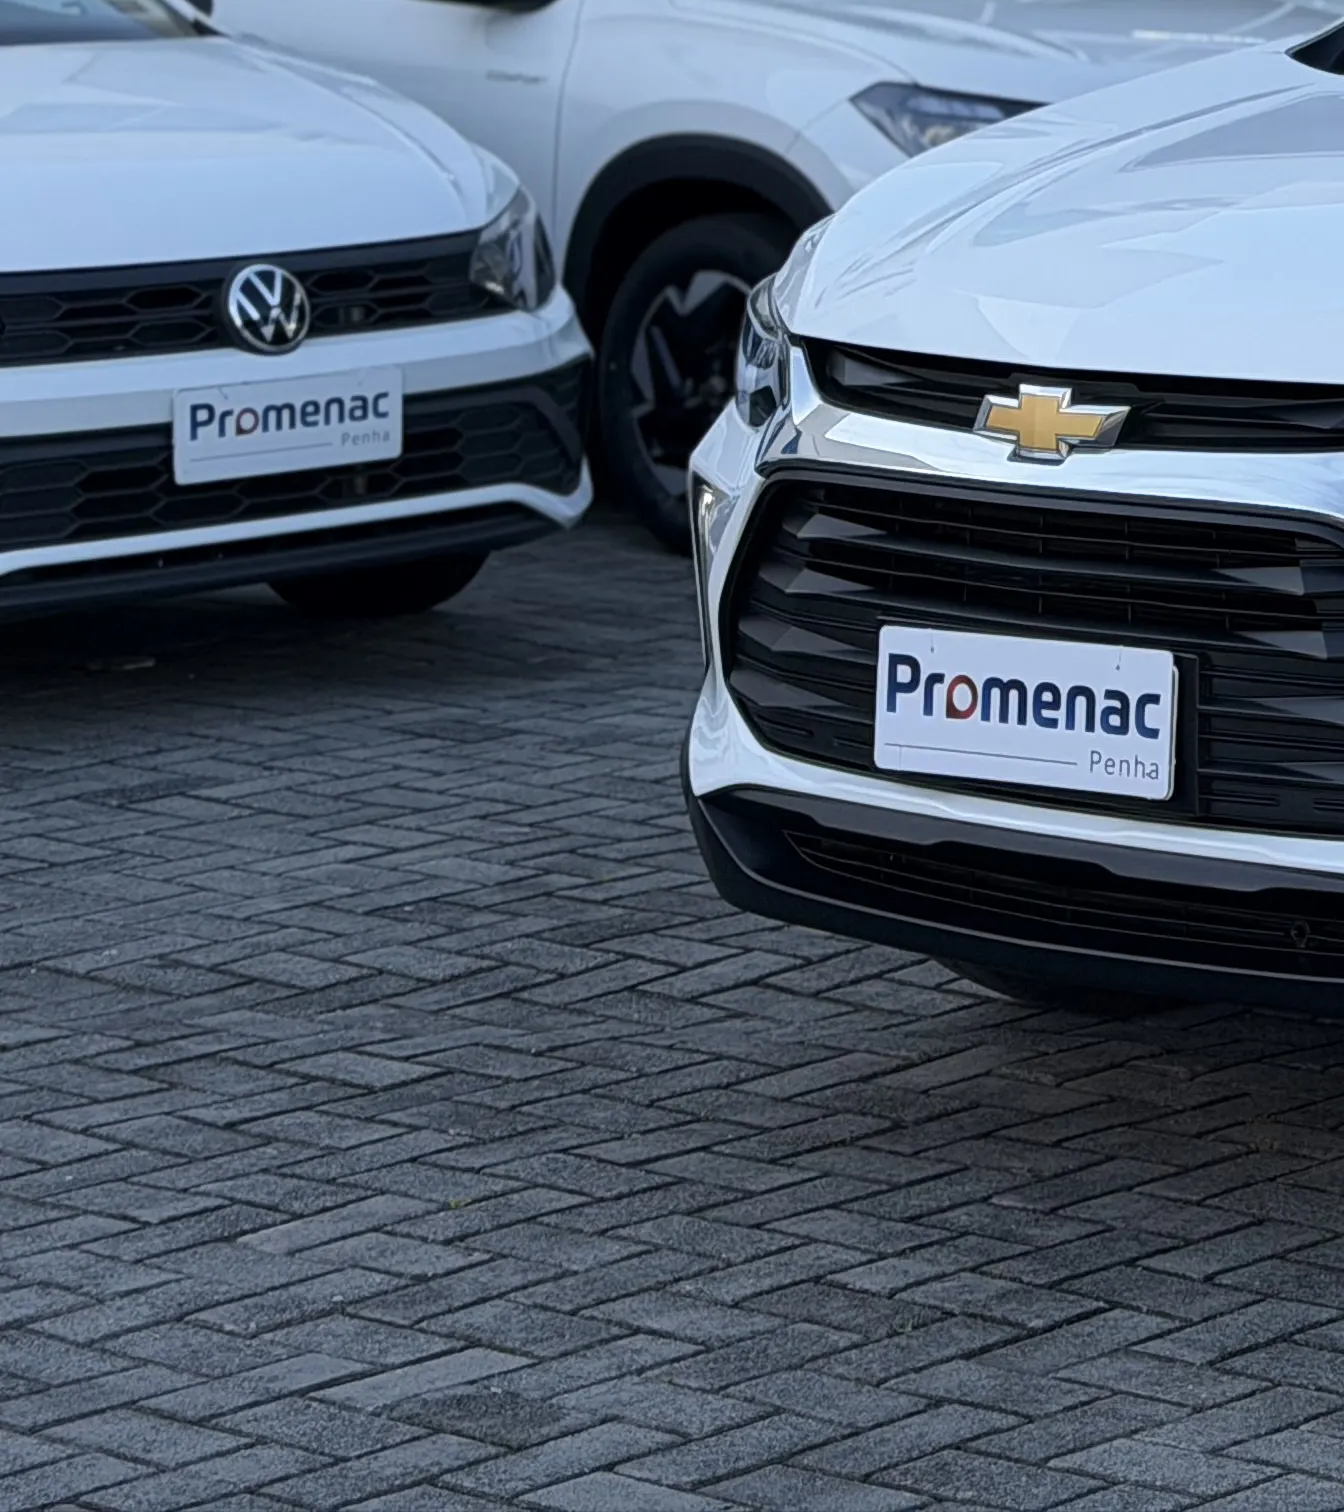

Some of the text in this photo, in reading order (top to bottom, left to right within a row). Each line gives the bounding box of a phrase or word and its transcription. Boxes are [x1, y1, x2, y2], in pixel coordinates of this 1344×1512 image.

[189, 391, 390, 442] Promenac
[341, 429, 391, 447] Penha
[885, 653, 1162, 739] Promenac
[1089, 749, 1160, 781] Penha
